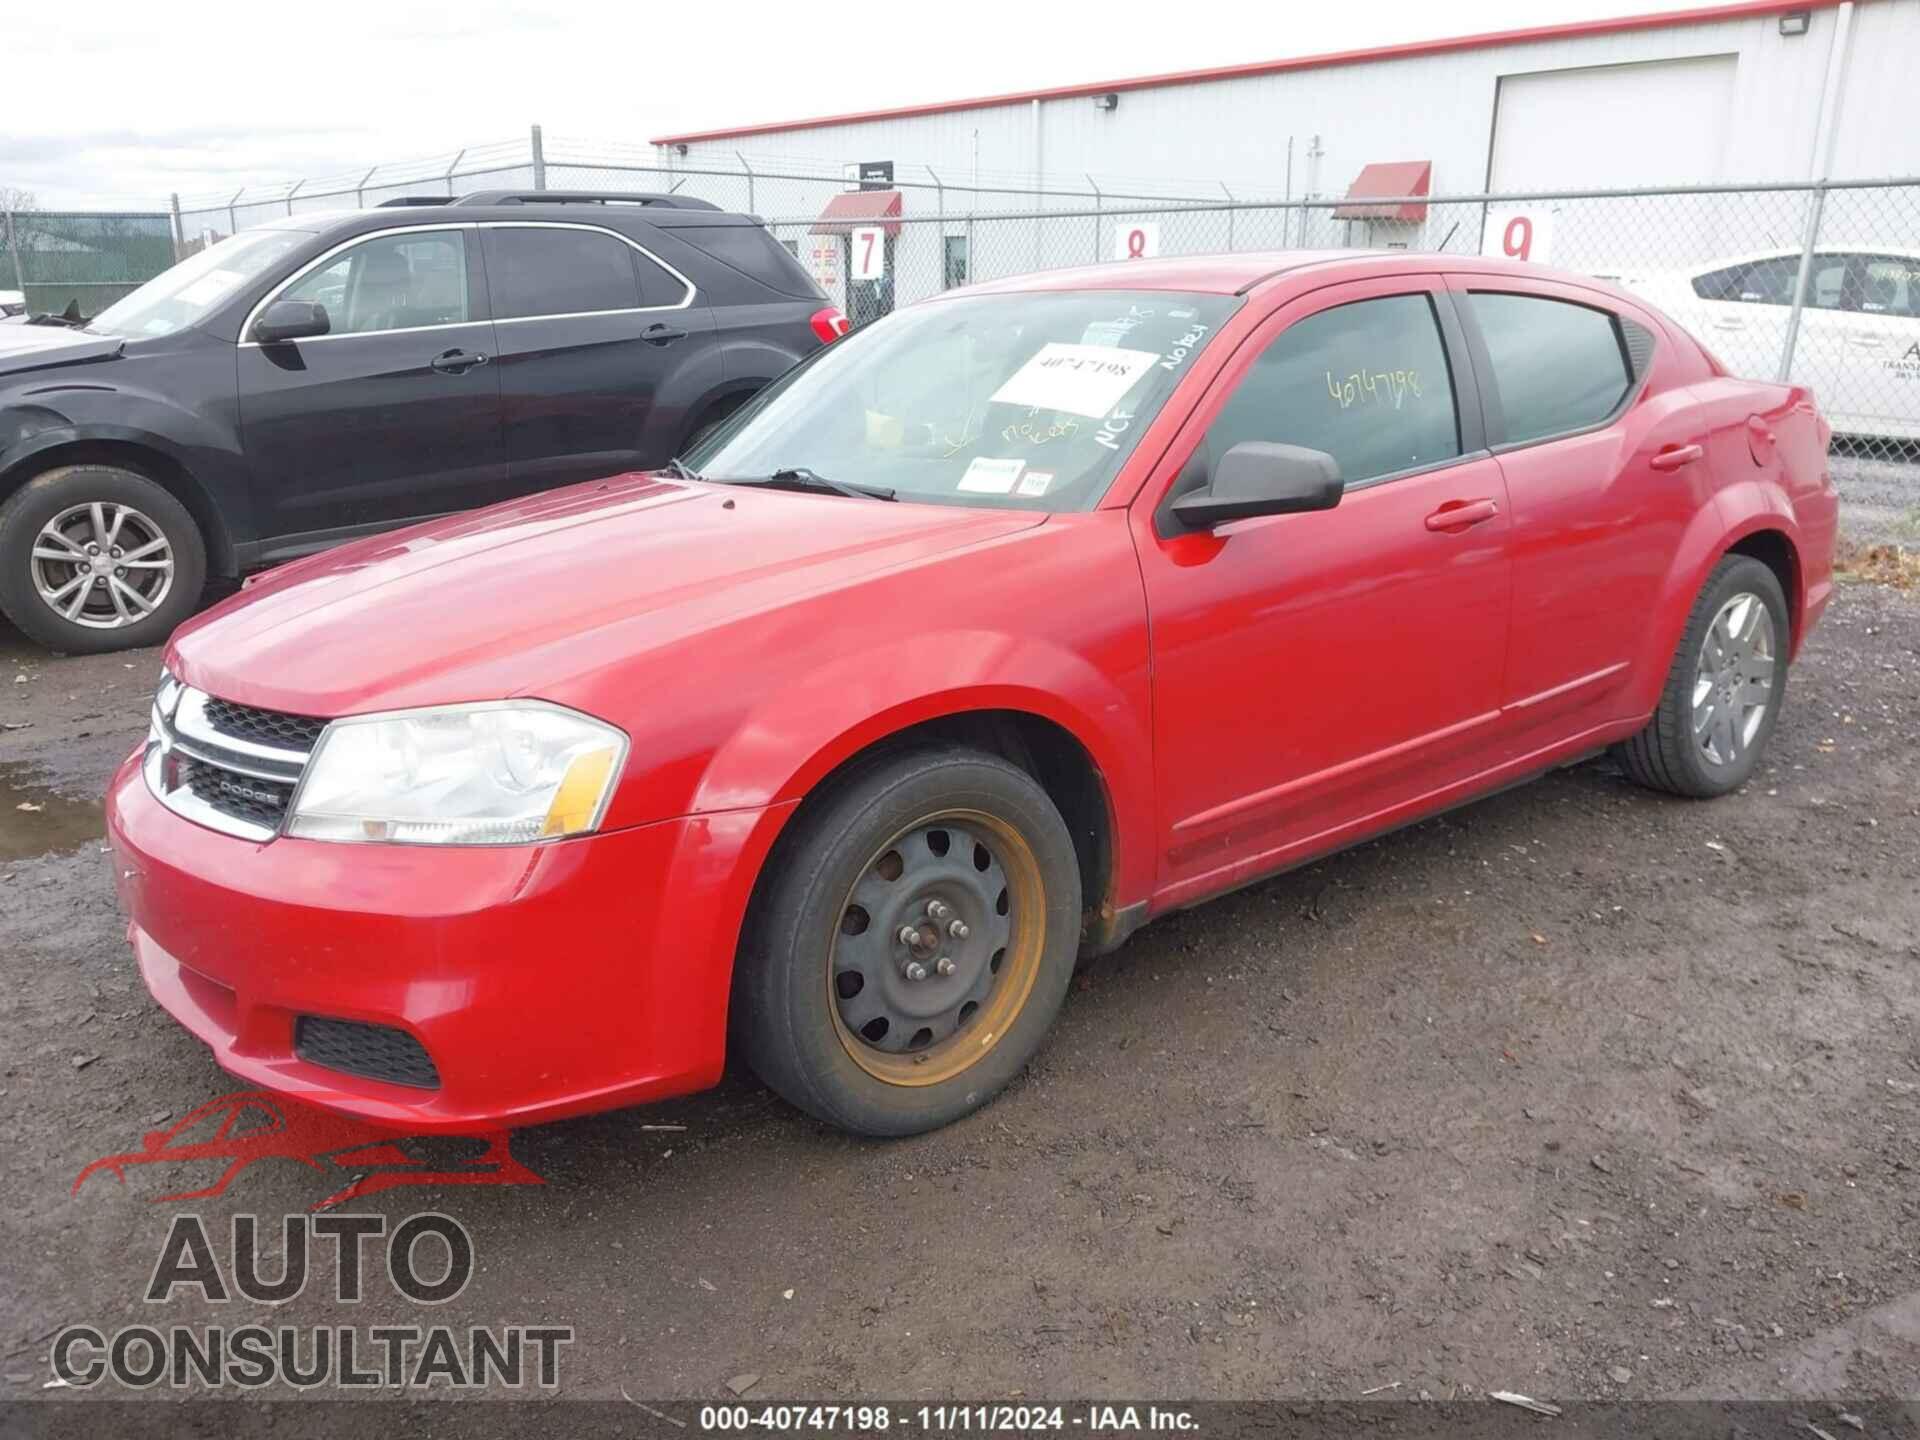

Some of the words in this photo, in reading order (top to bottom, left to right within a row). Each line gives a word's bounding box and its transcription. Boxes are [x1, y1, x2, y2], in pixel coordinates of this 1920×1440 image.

[861, 233, 876, 275] 7
[1503, 216, 1533, 262] 9
[219, 780, 280, 805] DODGE
